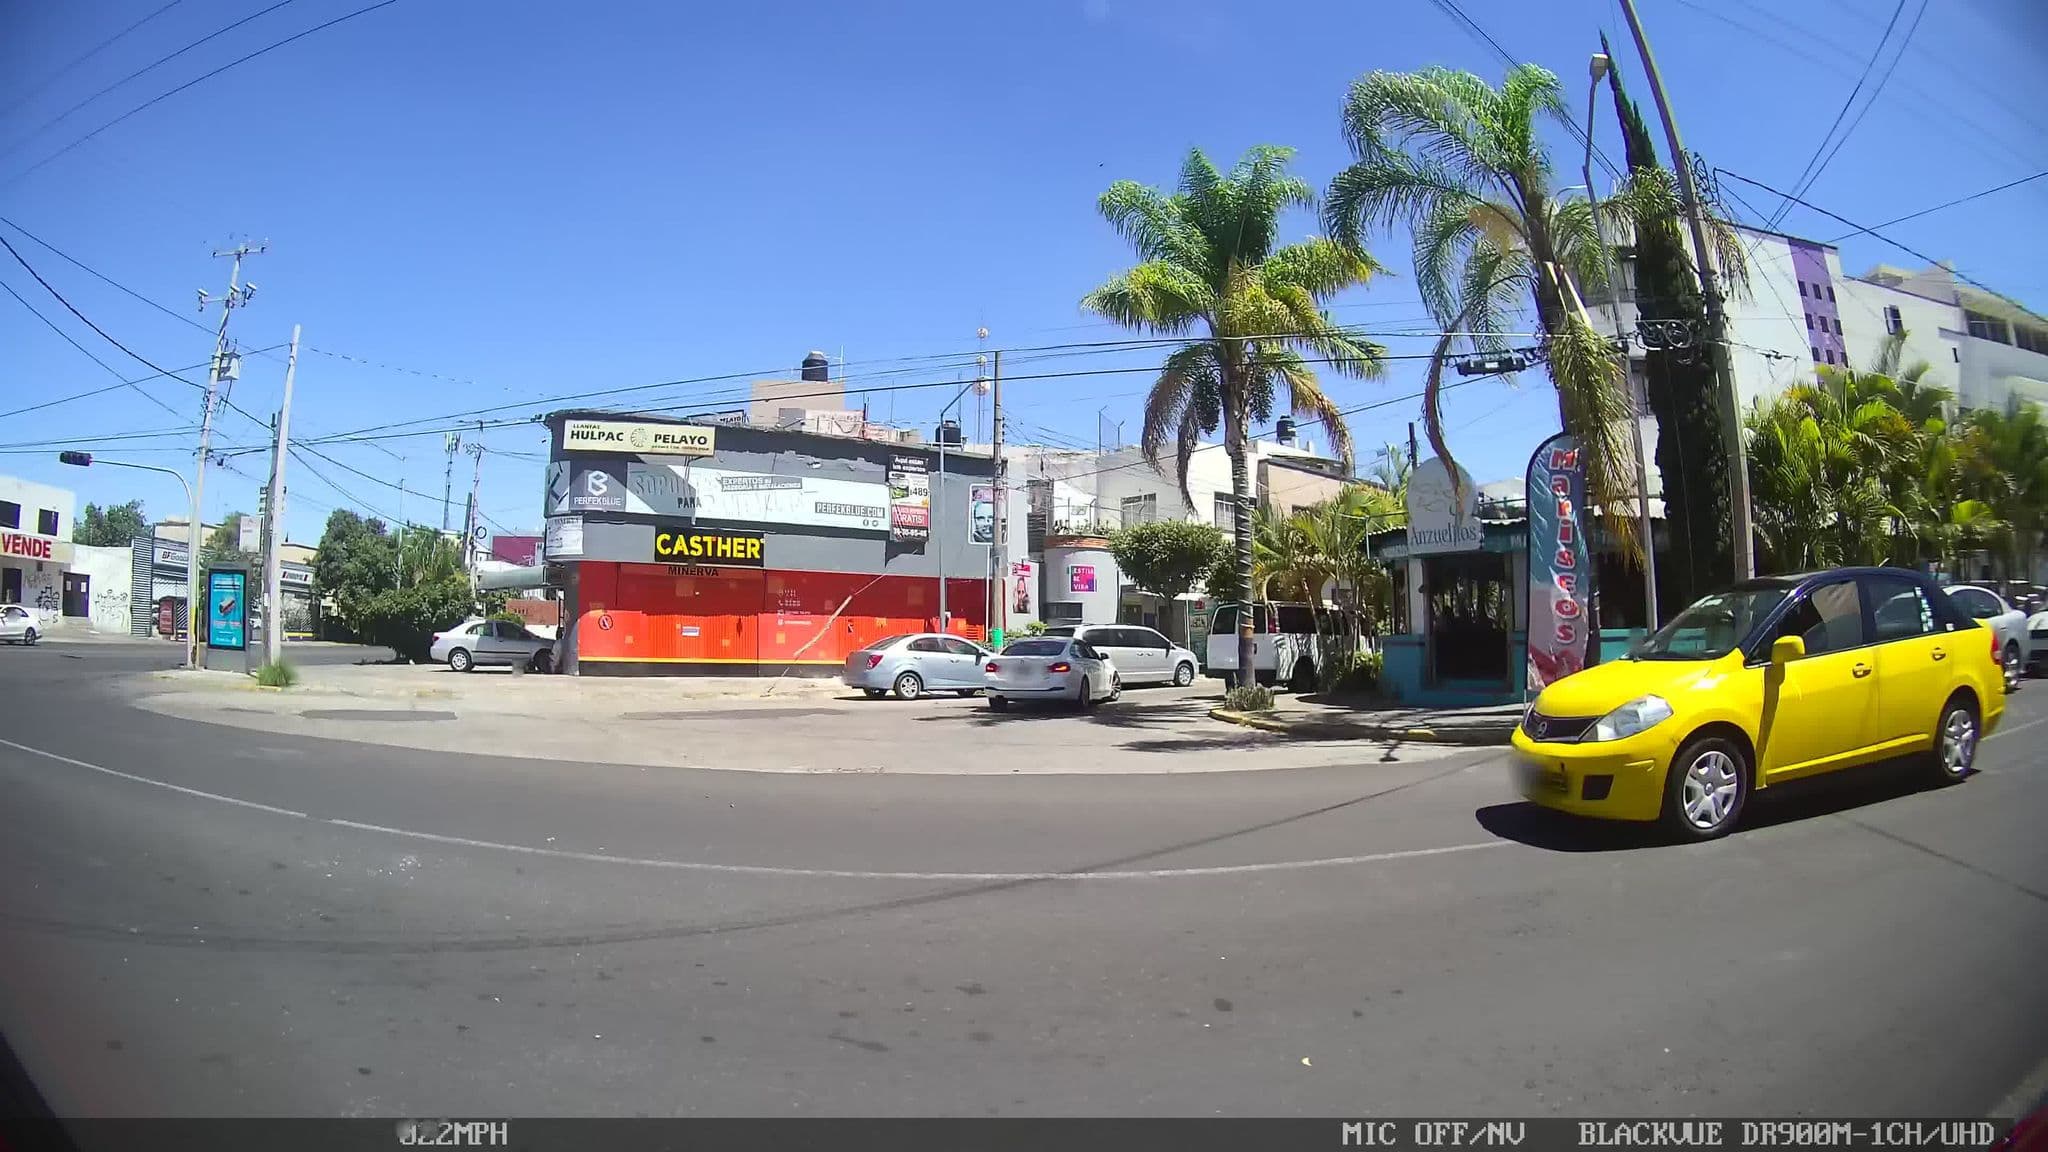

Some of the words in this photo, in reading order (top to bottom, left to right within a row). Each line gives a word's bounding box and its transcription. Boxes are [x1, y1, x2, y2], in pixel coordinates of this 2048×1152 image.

[570, 431, 624, 441] HULPAC
[653, 434, 708, 445] PELAYO
[815, 502, 885, 518] PERFEKBLUE.COM
[1, 532, 53, 561] VENDE
[656, 533, 761, 560] CASTHER
[667, 566, 720, 578] MINERVA
